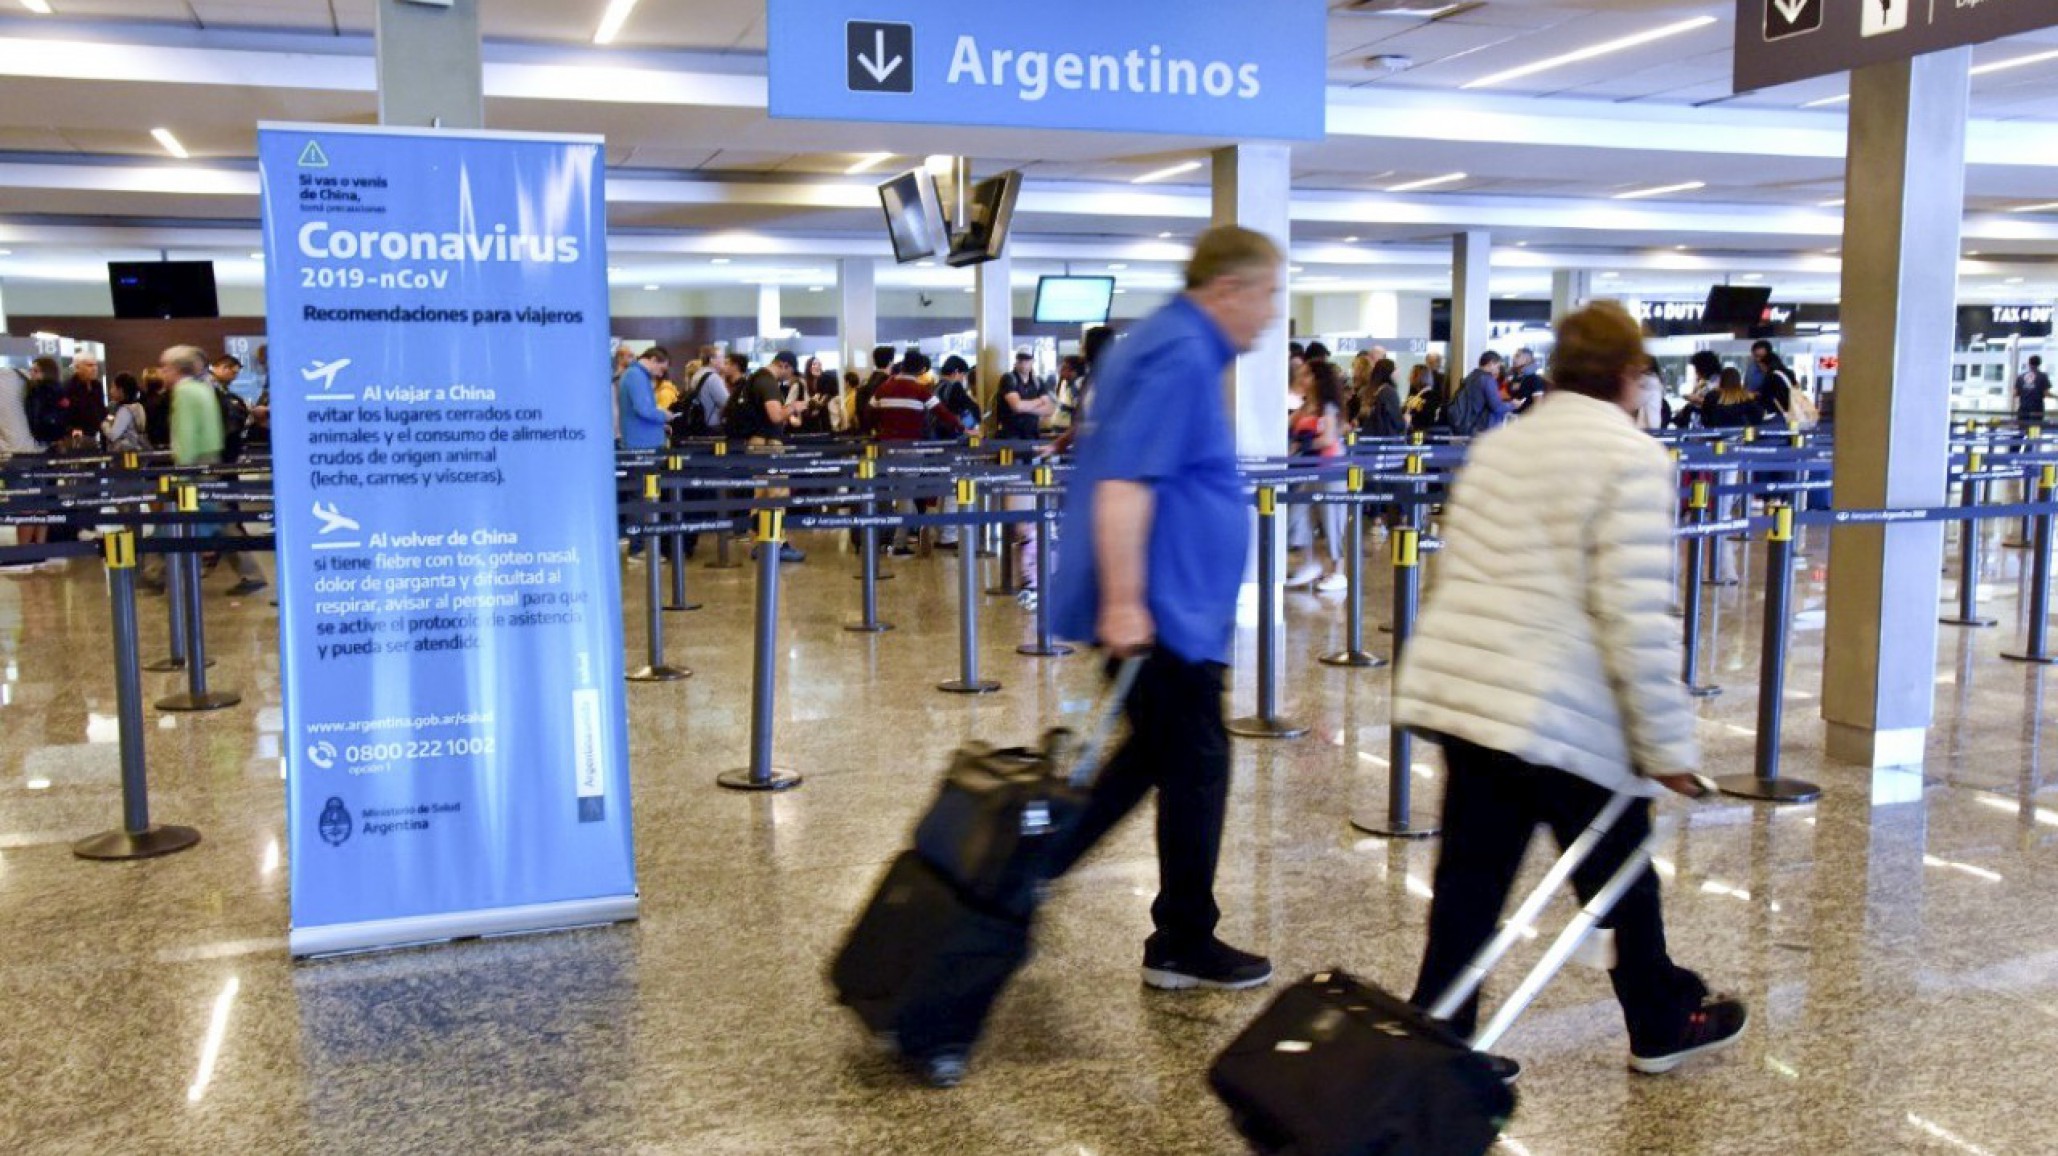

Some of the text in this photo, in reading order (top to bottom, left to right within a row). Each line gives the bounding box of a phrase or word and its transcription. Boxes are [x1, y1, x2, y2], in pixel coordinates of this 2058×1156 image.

[947, 35, 1260, 100] Argentinos
[299, 174, 312, 186] Si
[315, 177, 337, 187] vas
[341, 178, 349, 187] o
[300, 189, 360, 202] de China,
[326, 204, 387, 214] precauciones
[298, 221, 579, 262] Coronavirus
[301, 267, 448, 289] 2019-nCoV
[303, 304, 583, 327] Recomendaciones para viajeros
[1992, 306, 2020, 323] TAX
[363, 384, 496, 404] Al viajar a China
[307, 405, 543, 426] evitar los lugares cerrados con
[308, 425, 586, 447] animales y el consumo de alimentos
[309, 446, 496, 468] crudos de origen animal
[310, 470, 364, 490] (leche,
[366, 472, 419, 485] carnes
[422, 473, 432, 488] y
[369, 529, 518, 548] Al volver de China
[314, 556, 327, 571] si
[330, 556, 371, 570] tiene
[375, 552, 421, 569] fiebre
[425, 553, 453, 567] con
[490, 551, 533, 570] goteo
[537, 547, 579, 564] nasal,
[314, 569, 561, 594] dolor de garganta y dificultad al
[316, 589, 587, 618] respirar, avisar al personal para que
[317, 621, 336, 635] se
[339, 617, 386, 634] active
[390, 616, 404, 631] el
[508, 608, 582, 627] asistencia
[317, 644, 327, 660] y
[331, 638, 382, 658] pueda
[306, 710, 495, 734] www.argentina.gob.ar/salud
[345, 737, 495, 763] 0800 222 1002
[362, 801, 461, 818] Ministerio de Salud
[362, 819, 429, 836] Argentina
